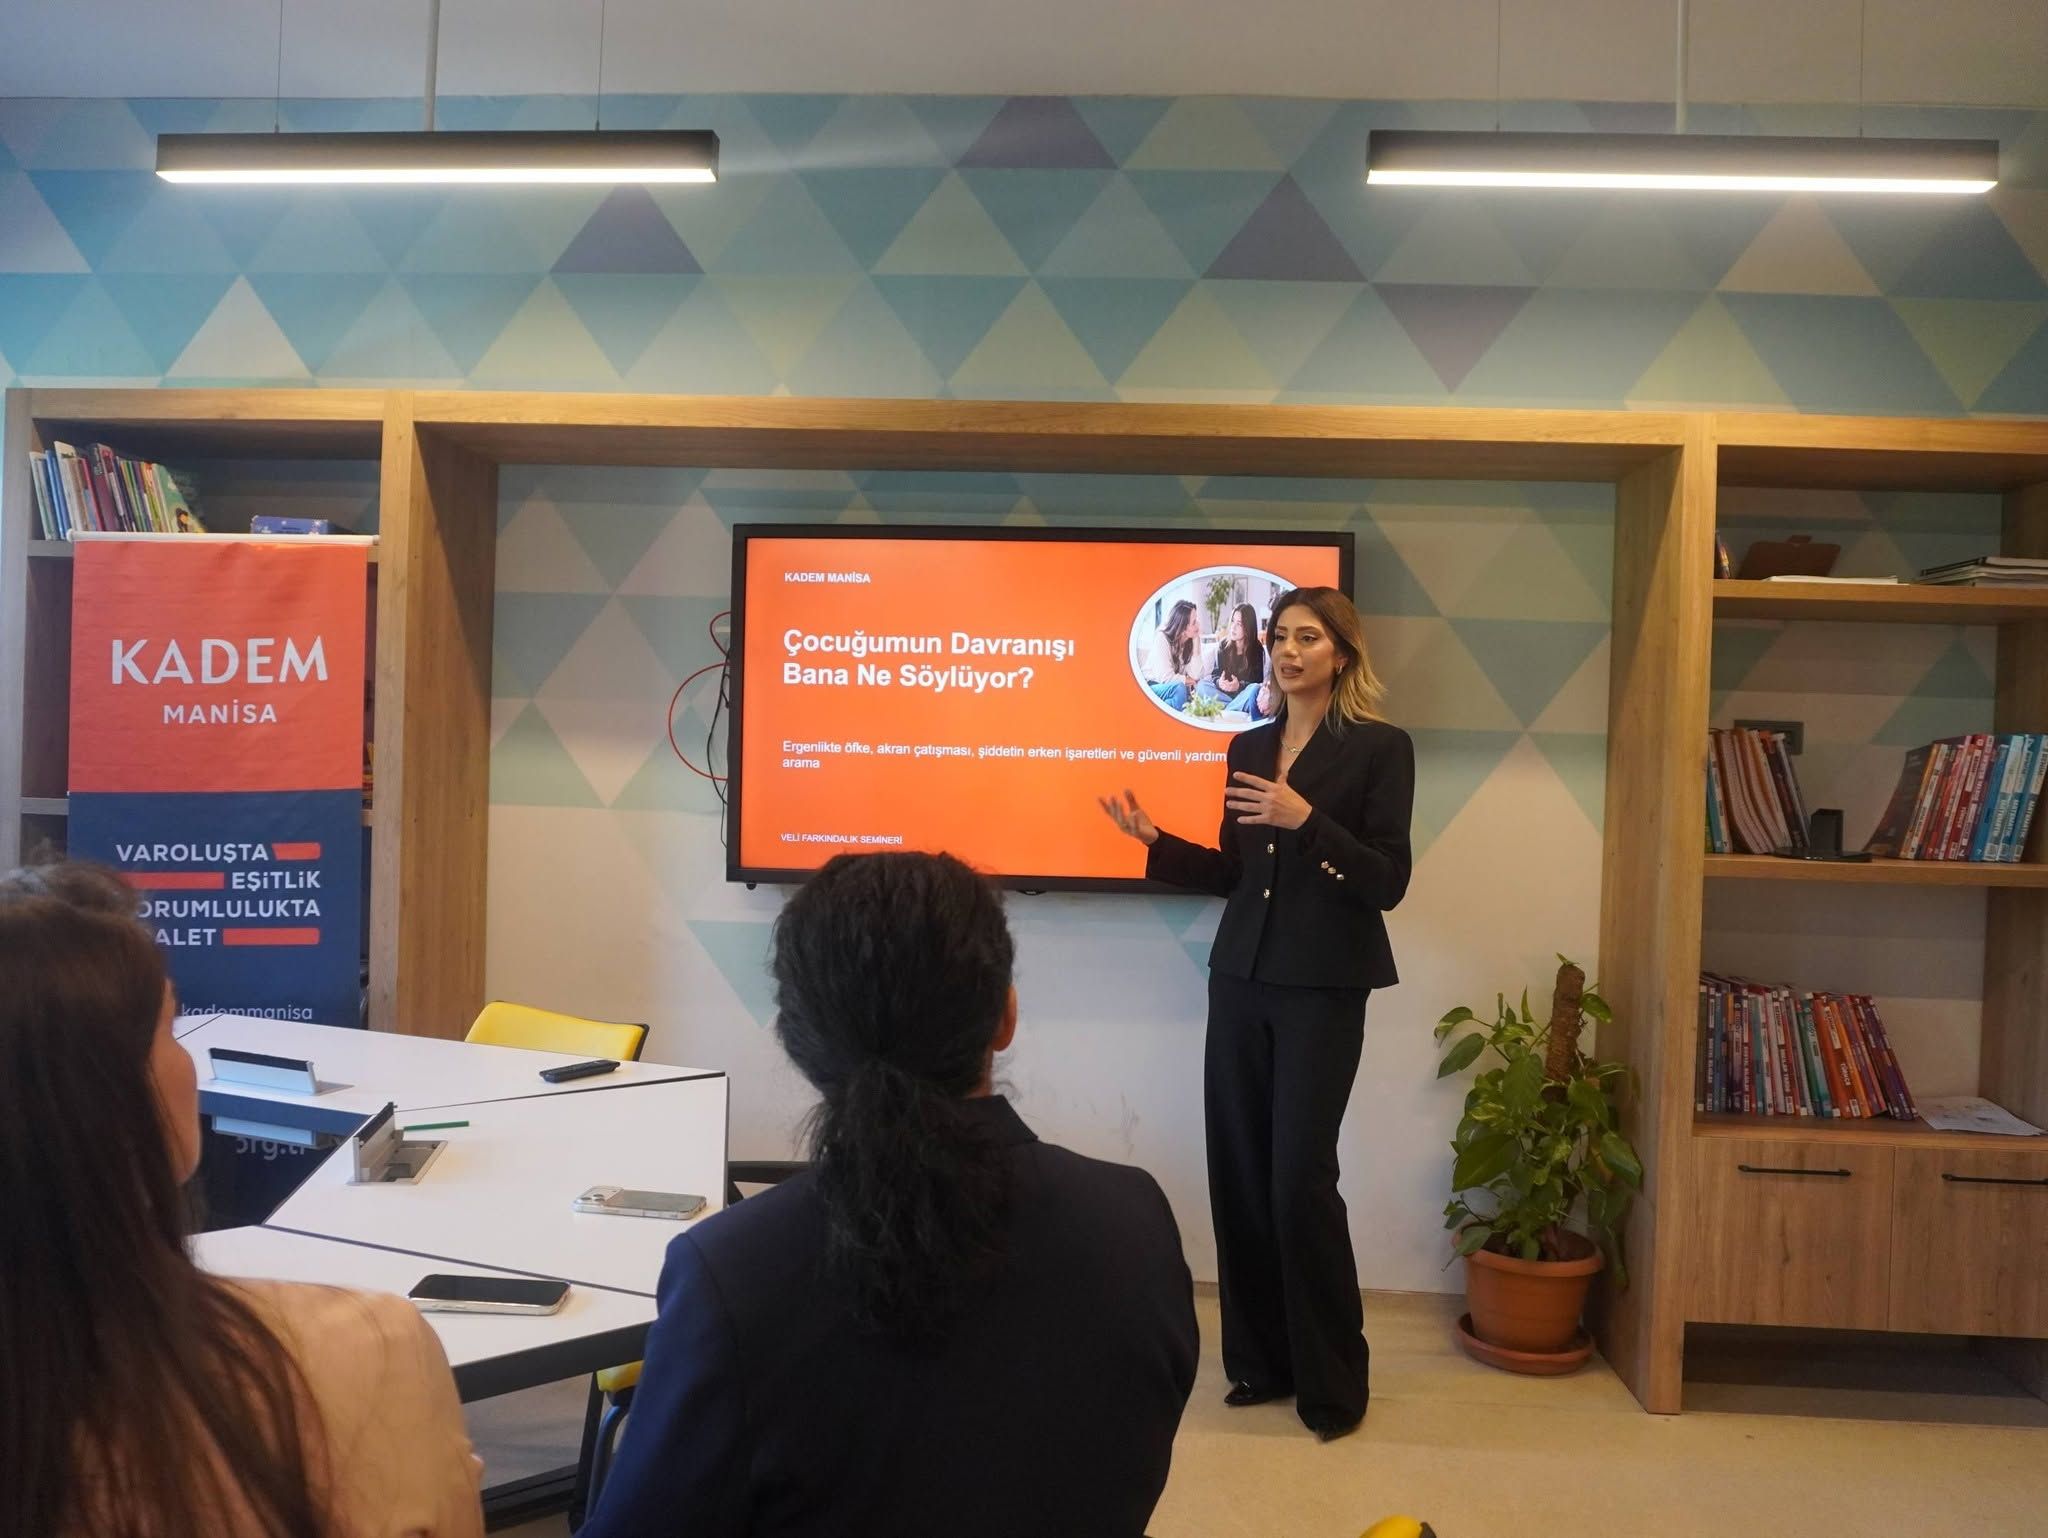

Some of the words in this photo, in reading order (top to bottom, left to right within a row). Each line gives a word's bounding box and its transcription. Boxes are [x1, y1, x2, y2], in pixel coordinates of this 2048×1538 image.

[784, 572, 825, 584] KADEM
[827, 570, 871, 584] MANİSA
[783, 629, 943, 659] Çocuğumun
[950, 631, 1076, 661] Davranışı
[111, 634, 329, 685] KADEM
[782, 663, 849, 686] Bana
[857, 663, 892, 687] Ne
[899, 662, 1035, 693] Söylüyor?
[162, 698, 278, 725] MANİSA
[782, 740, 842, 755] Ergenlikte
[844, 741, 874, 755] öfke,
[876, 743, 911, 755] akran
[913, 743, 974, 758] çatışması,
[977, 744, 1025, 759] şiddetin
[1027, 746, 1062, 758] erken
[1065, 746, 1117, 761] işaretleri
[1119, 749, 1135, 760] ve
[1137, 748, 1182, 763] güvenli
[1184, 749, 1227, 764] yardım
[782, 758, 821, 769] arama
[780, 832, 800, 843] VELİ
[801, 833, 859, 845] FARKINDALIK
[860, 834, 904, 846] SEMİNERİ
[115, 842, 269, 864] VAROLUŞTA
[231, 869, 321, 892] EŞİTLİK
[136, 899, 321, 918] ORUMLULUKTA
[154, 928, 217, 946] ALET
